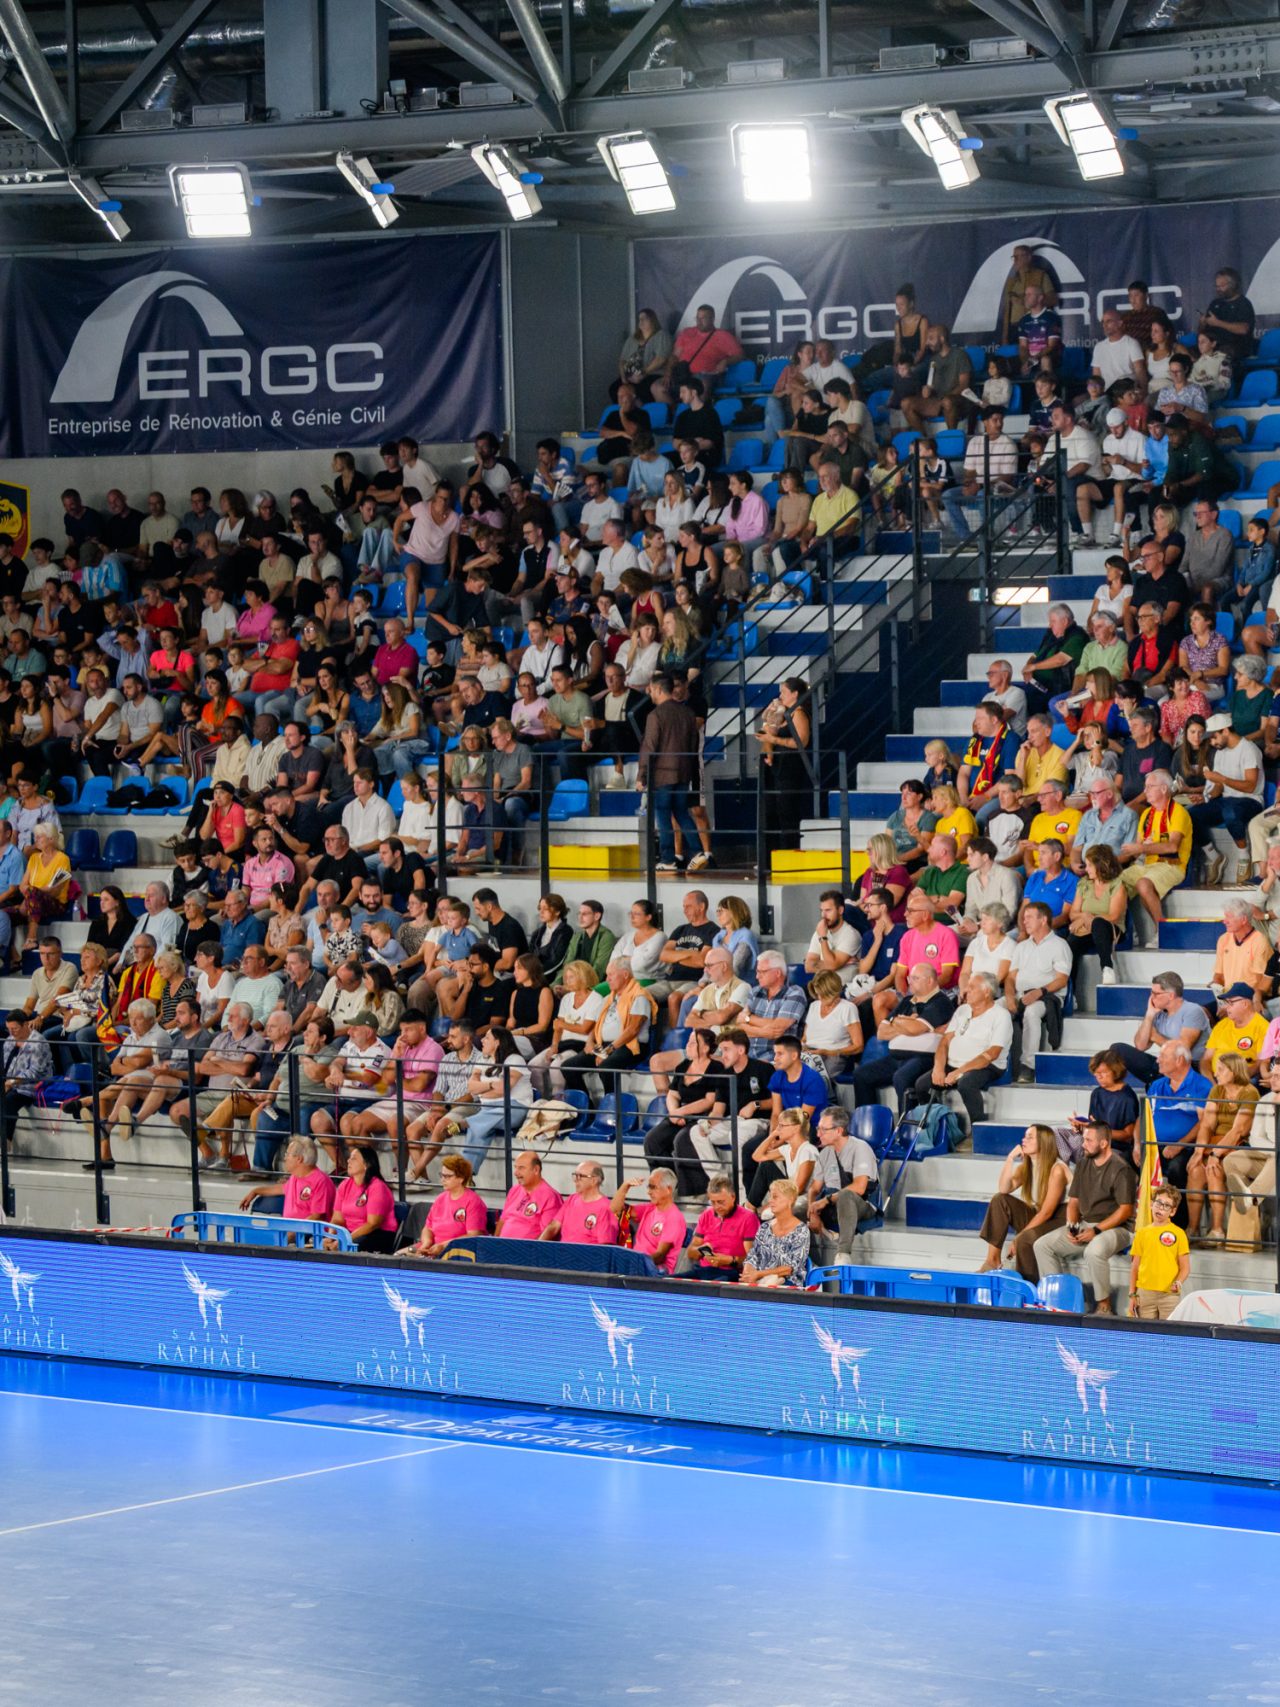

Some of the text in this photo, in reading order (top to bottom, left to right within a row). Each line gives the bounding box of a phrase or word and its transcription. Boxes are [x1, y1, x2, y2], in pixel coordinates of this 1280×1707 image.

[735, 303, 898, 344] ERGC
[138, 342, 384, 400] ERGC
[48, 406, 385, 437] Entreprise de Rénovation & Génie Civil
[3, 1313, 54, 1328] AINT
[4, 1328, 70, 1350] PHAËL
[172, 1329, 245, 1346] SAINT
[372, 1348, 447, 1367] SAINT
[578, 1369, 658, 1389] SAINT
[799, 1393, 887, 1412] SAINT
[348, 1413, 405, 1427] LE
[1041, 1416, 1136, 1438] SAINT
